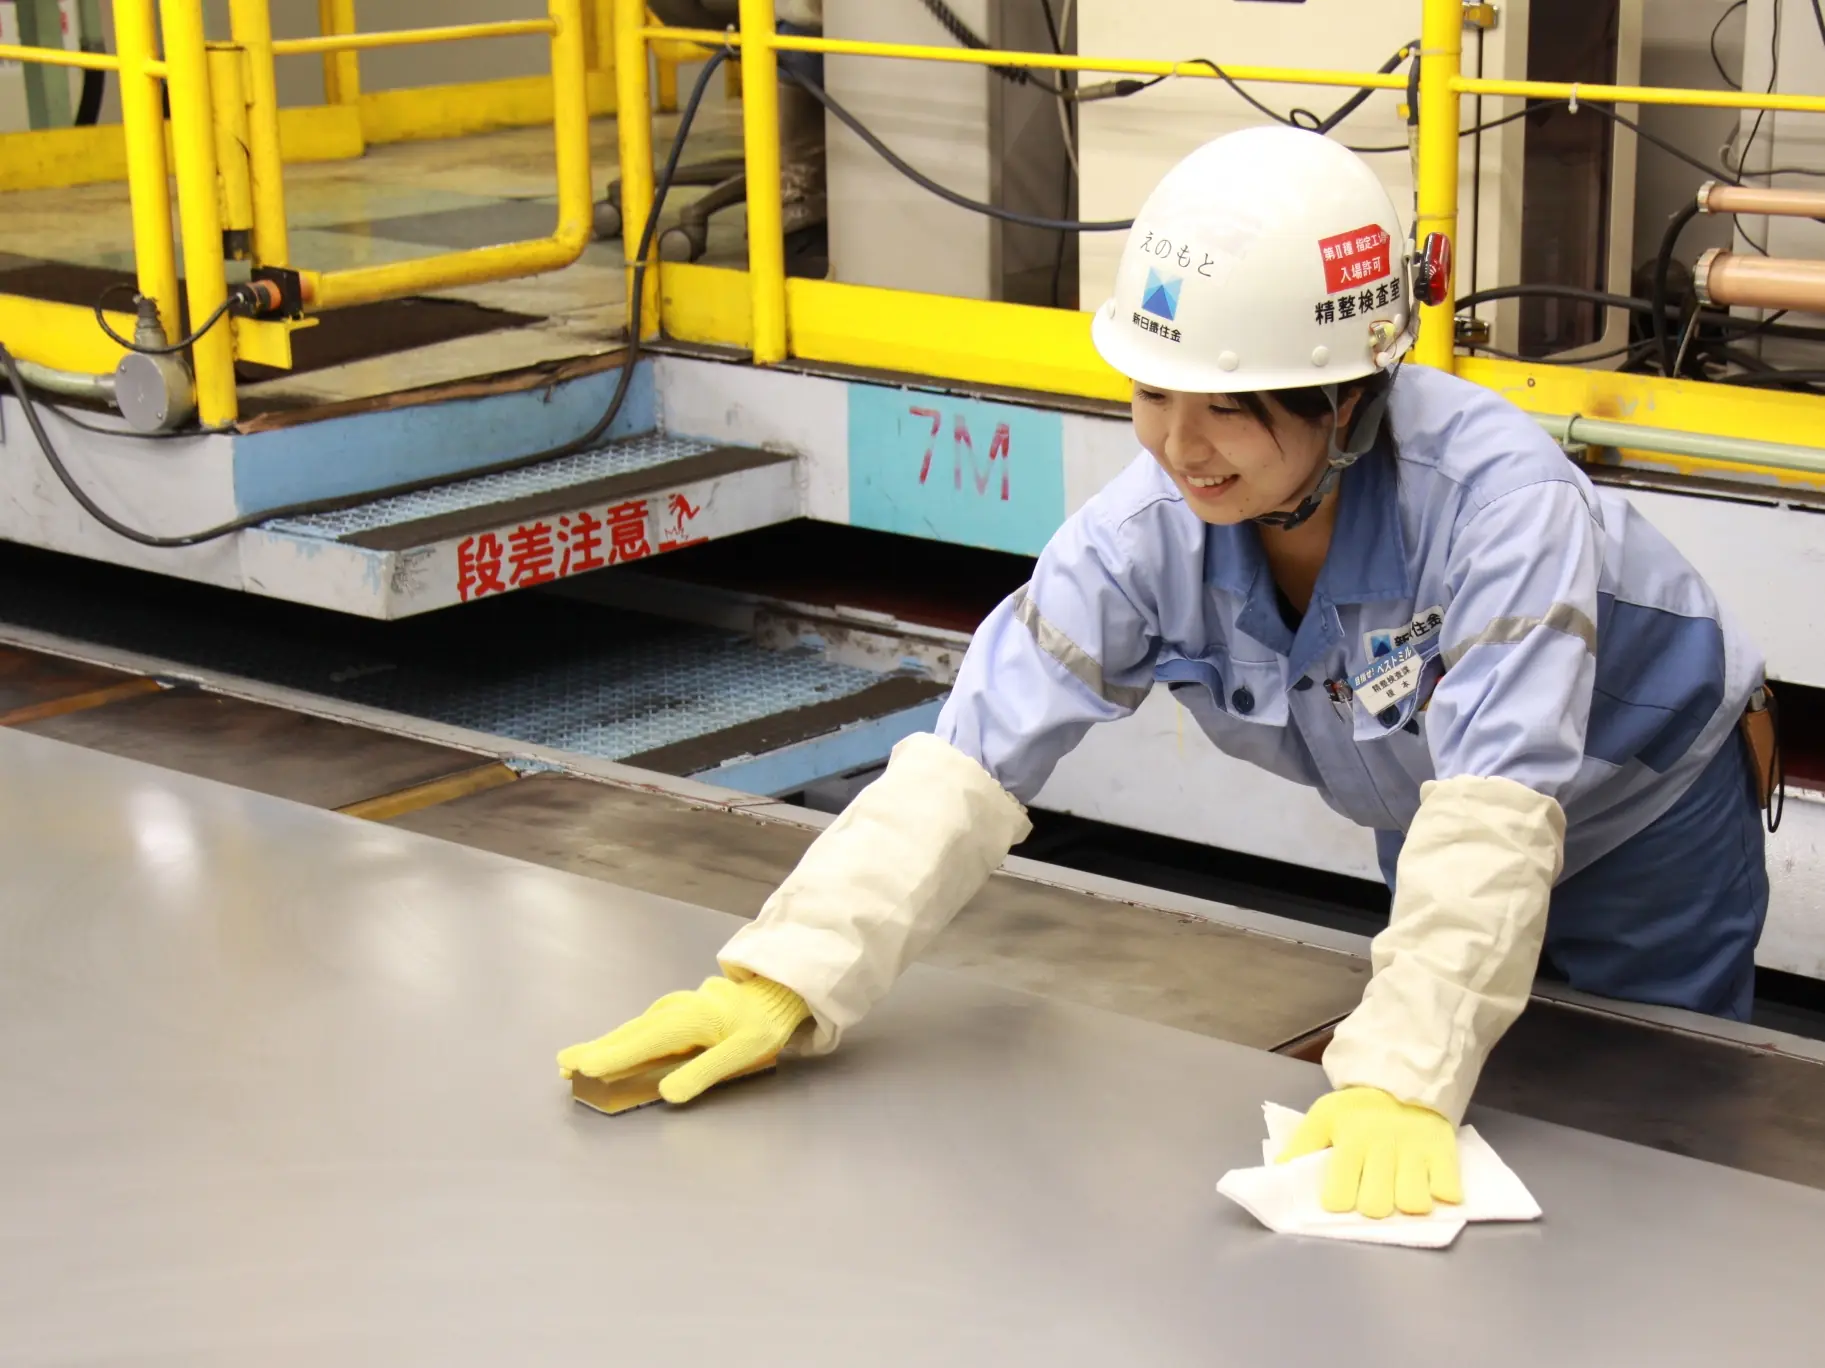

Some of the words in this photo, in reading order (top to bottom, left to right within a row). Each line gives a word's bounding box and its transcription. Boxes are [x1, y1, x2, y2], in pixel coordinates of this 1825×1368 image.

[1140, 230, 1215, 278] えのもと
[1340, 256, 1381, 283] 入場許可
[1315, 277, 1401, 325] 精整検査室
[909, 406, 1010, 501] 7M
[457, 500, 652, 603] 段差注意
